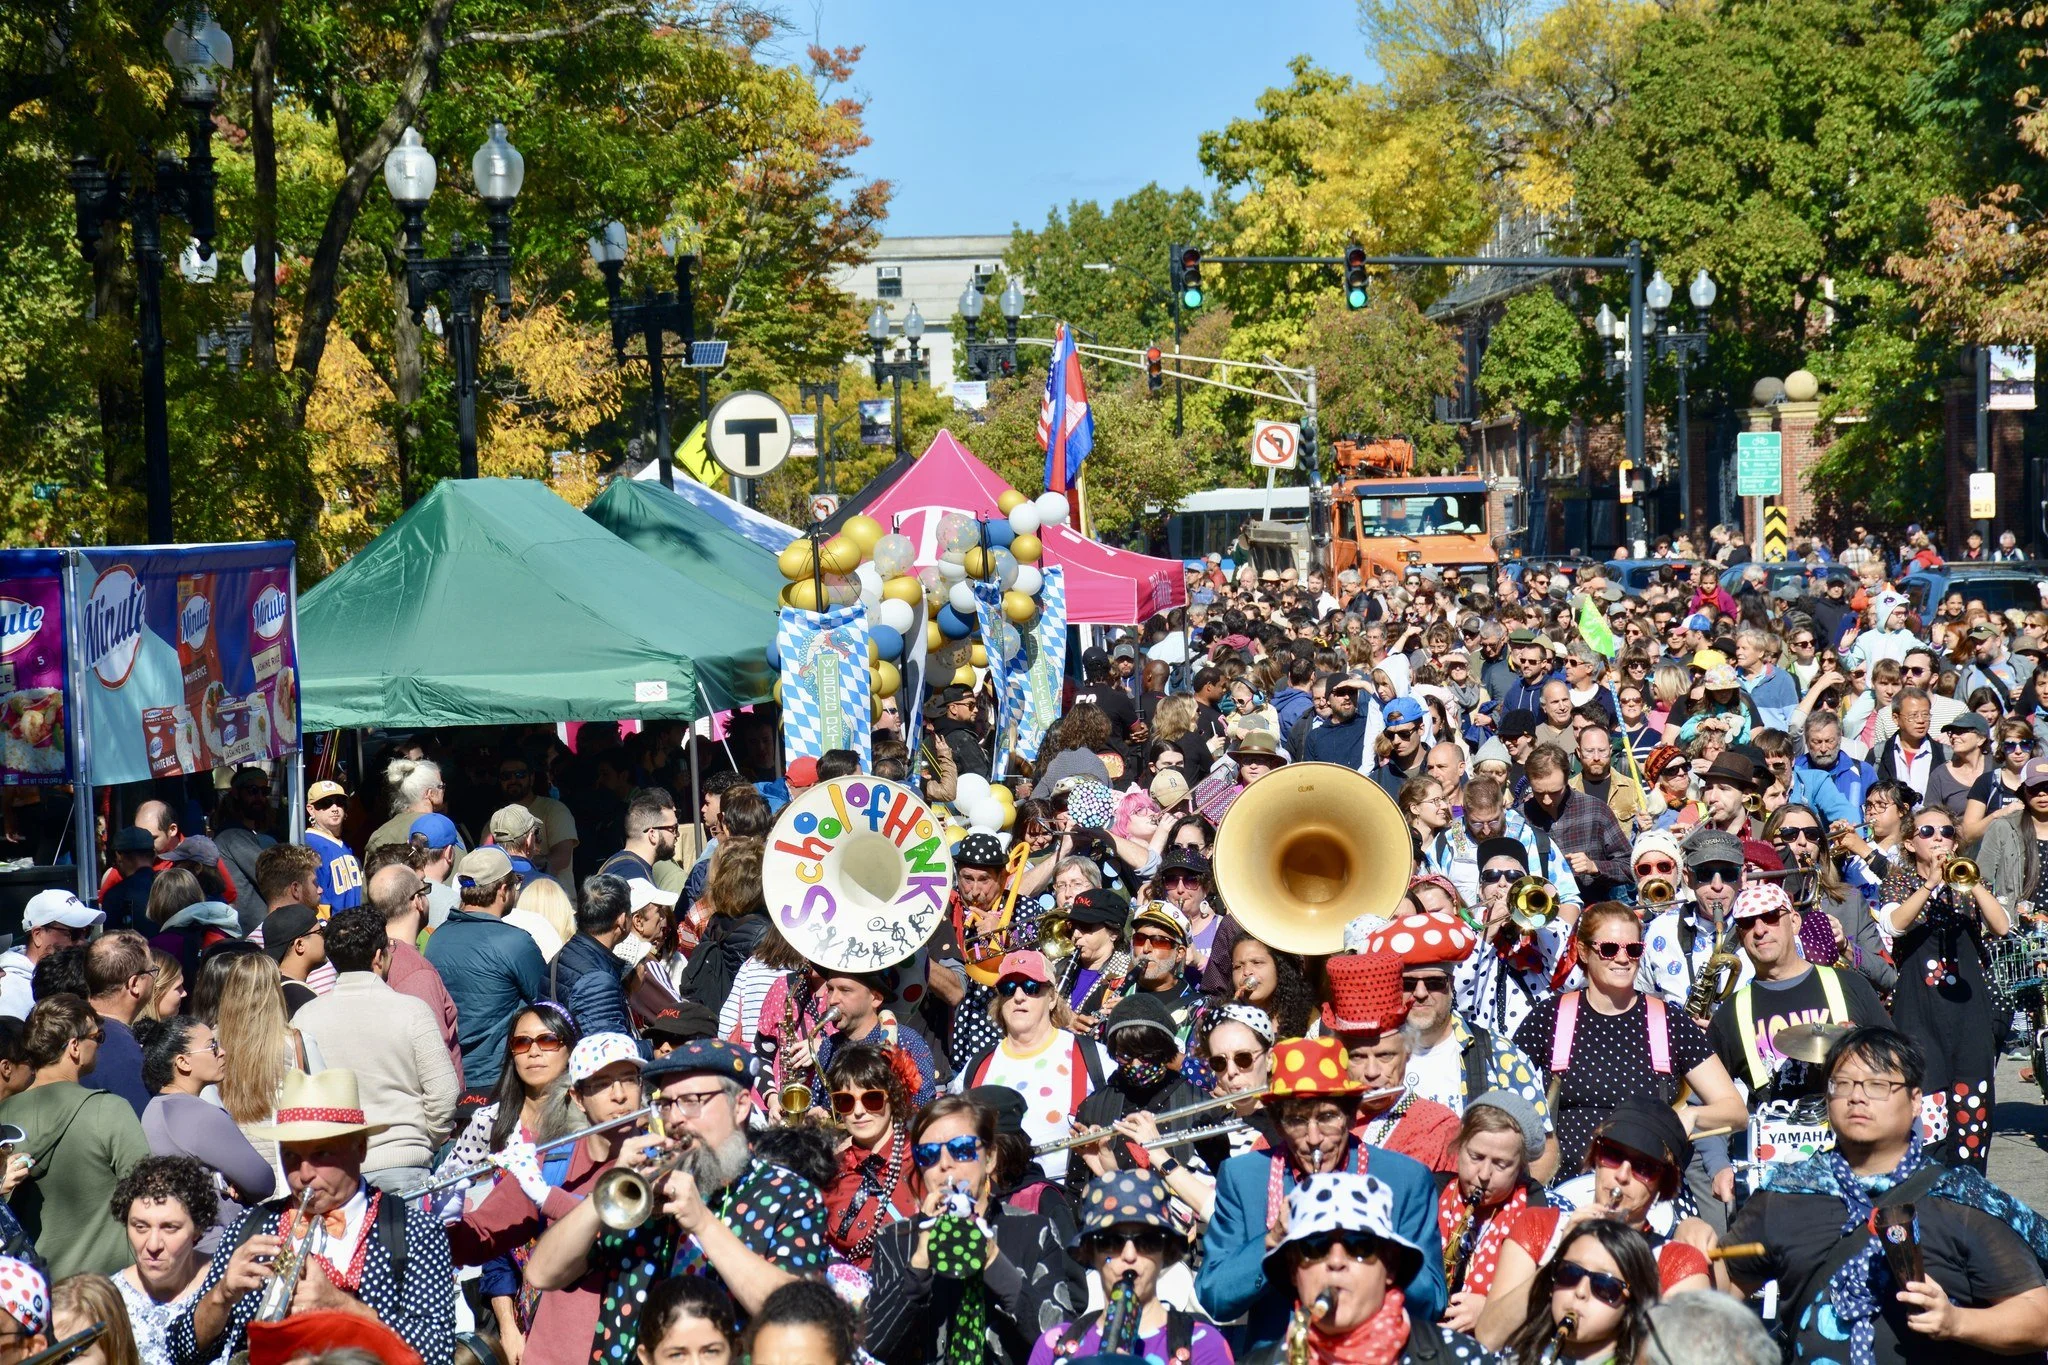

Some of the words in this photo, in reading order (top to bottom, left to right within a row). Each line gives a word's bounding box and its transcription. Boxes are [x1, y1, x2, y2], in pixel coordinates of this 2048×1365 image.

[725, 418, 777, 466] T
[890, 506, 977, 566] T
[84, 581, 146, 667] Minute
[182, 602, 210, 641] Minute
[254, 593, 286, 629] Minute
[184, 670, 198, 684] WHITE
[822, 659, 838, 711] WUSONG
[152, 757, 166, 773] WHITE
[166, 754, 176, 767] RICE
[775, 784, 852, 928] School
[846, 782, 891, 832] of
[1769, 1130, 1834, 1145] YAMAHA
